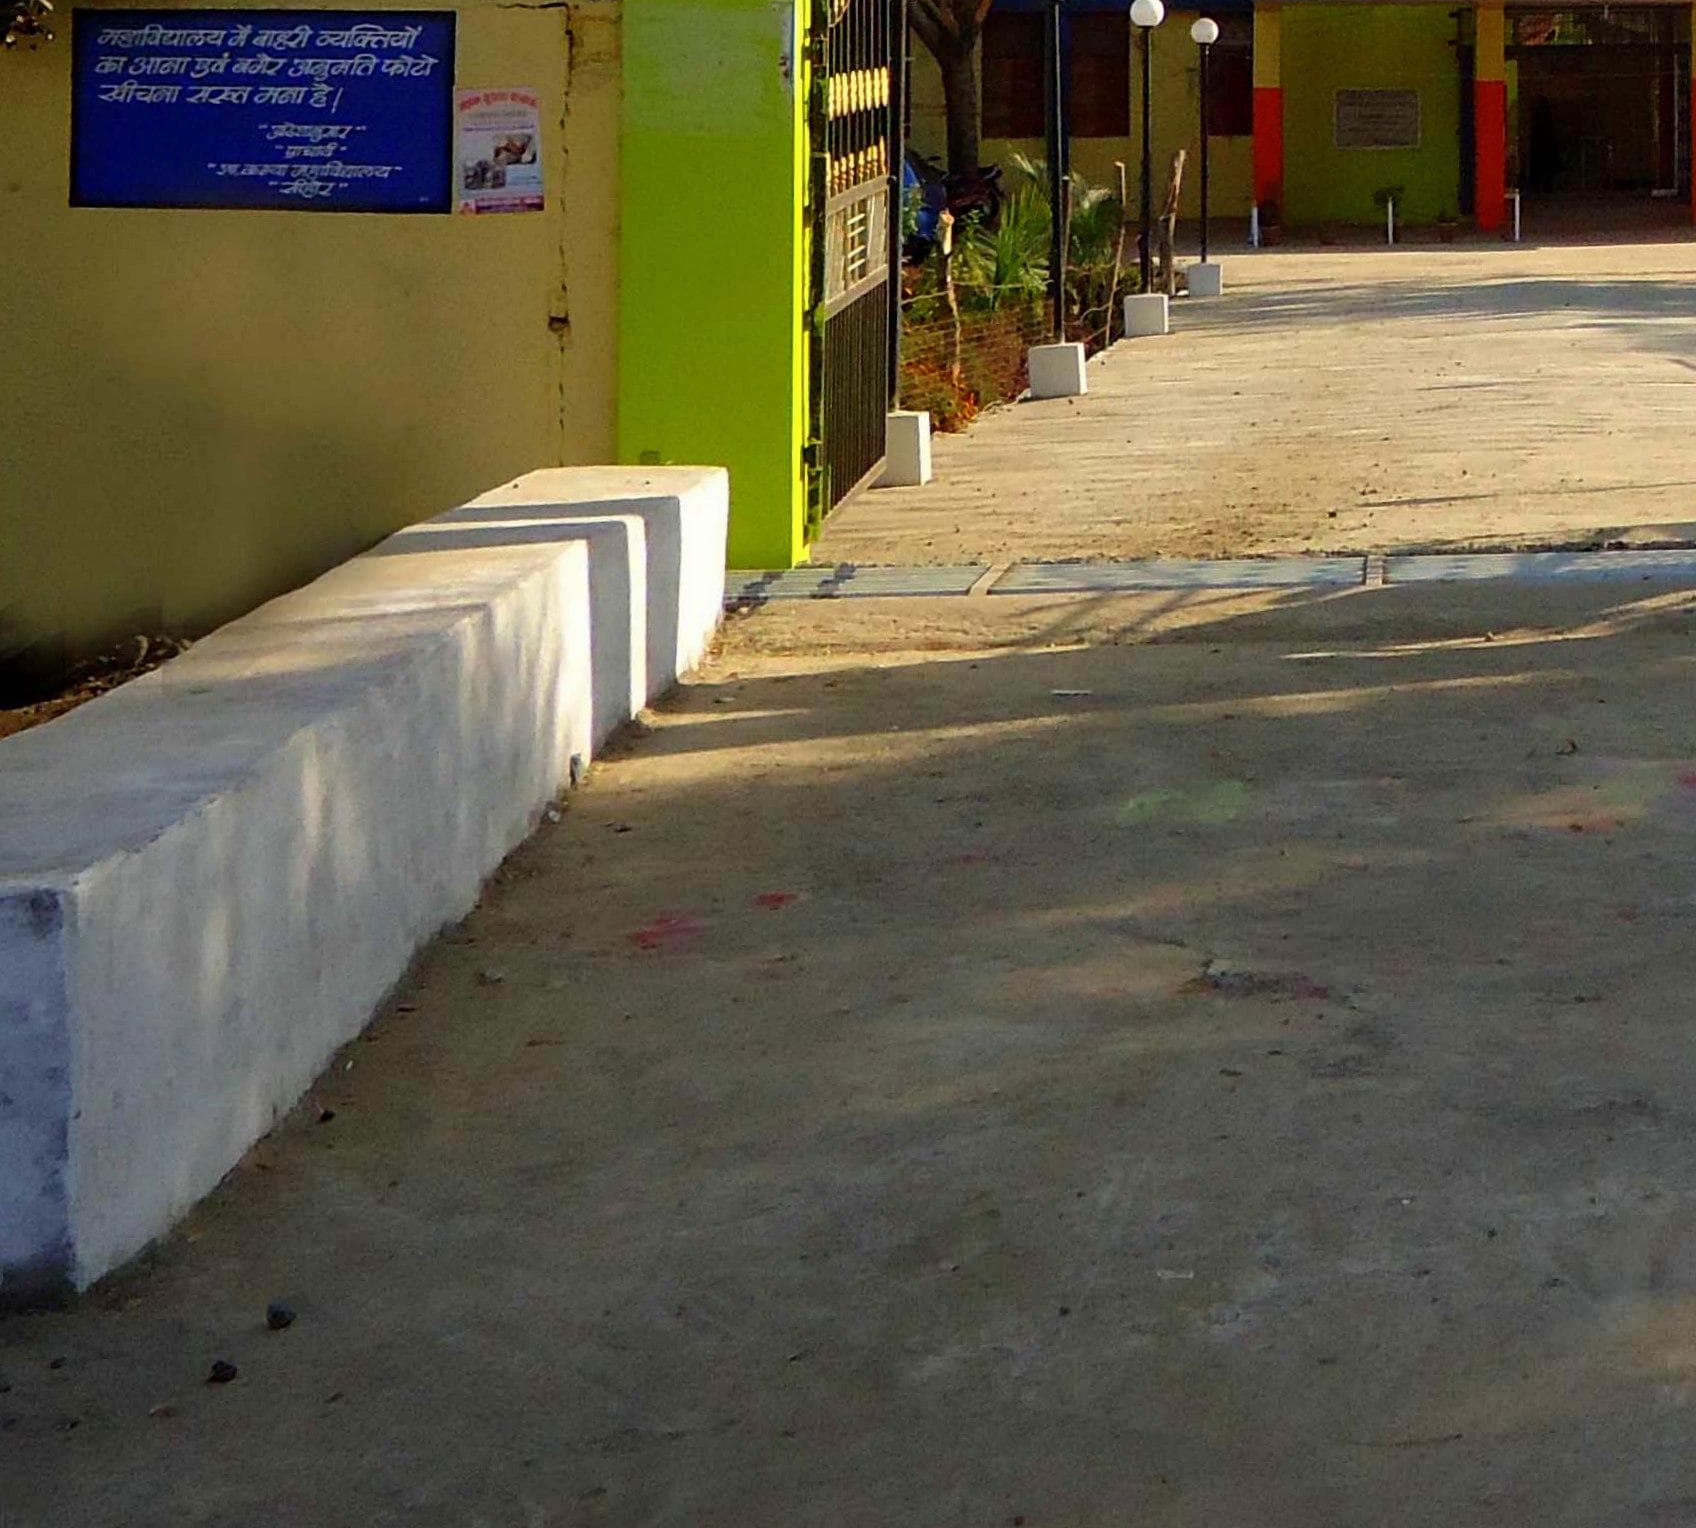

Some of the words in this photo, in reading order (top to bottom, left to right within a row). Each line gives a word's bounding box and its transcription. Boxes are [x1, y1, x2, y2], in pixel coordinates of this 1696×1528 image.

[97, 24, 227, 49] महाविद्यालय
[252, 25, 313, 50] बाहरी
[95, 56, 128, 74] का
[129, 56, 191, 75] आना
[288, 53, 378, 81] अनुमति
[253, 86, 309, 105] मना
